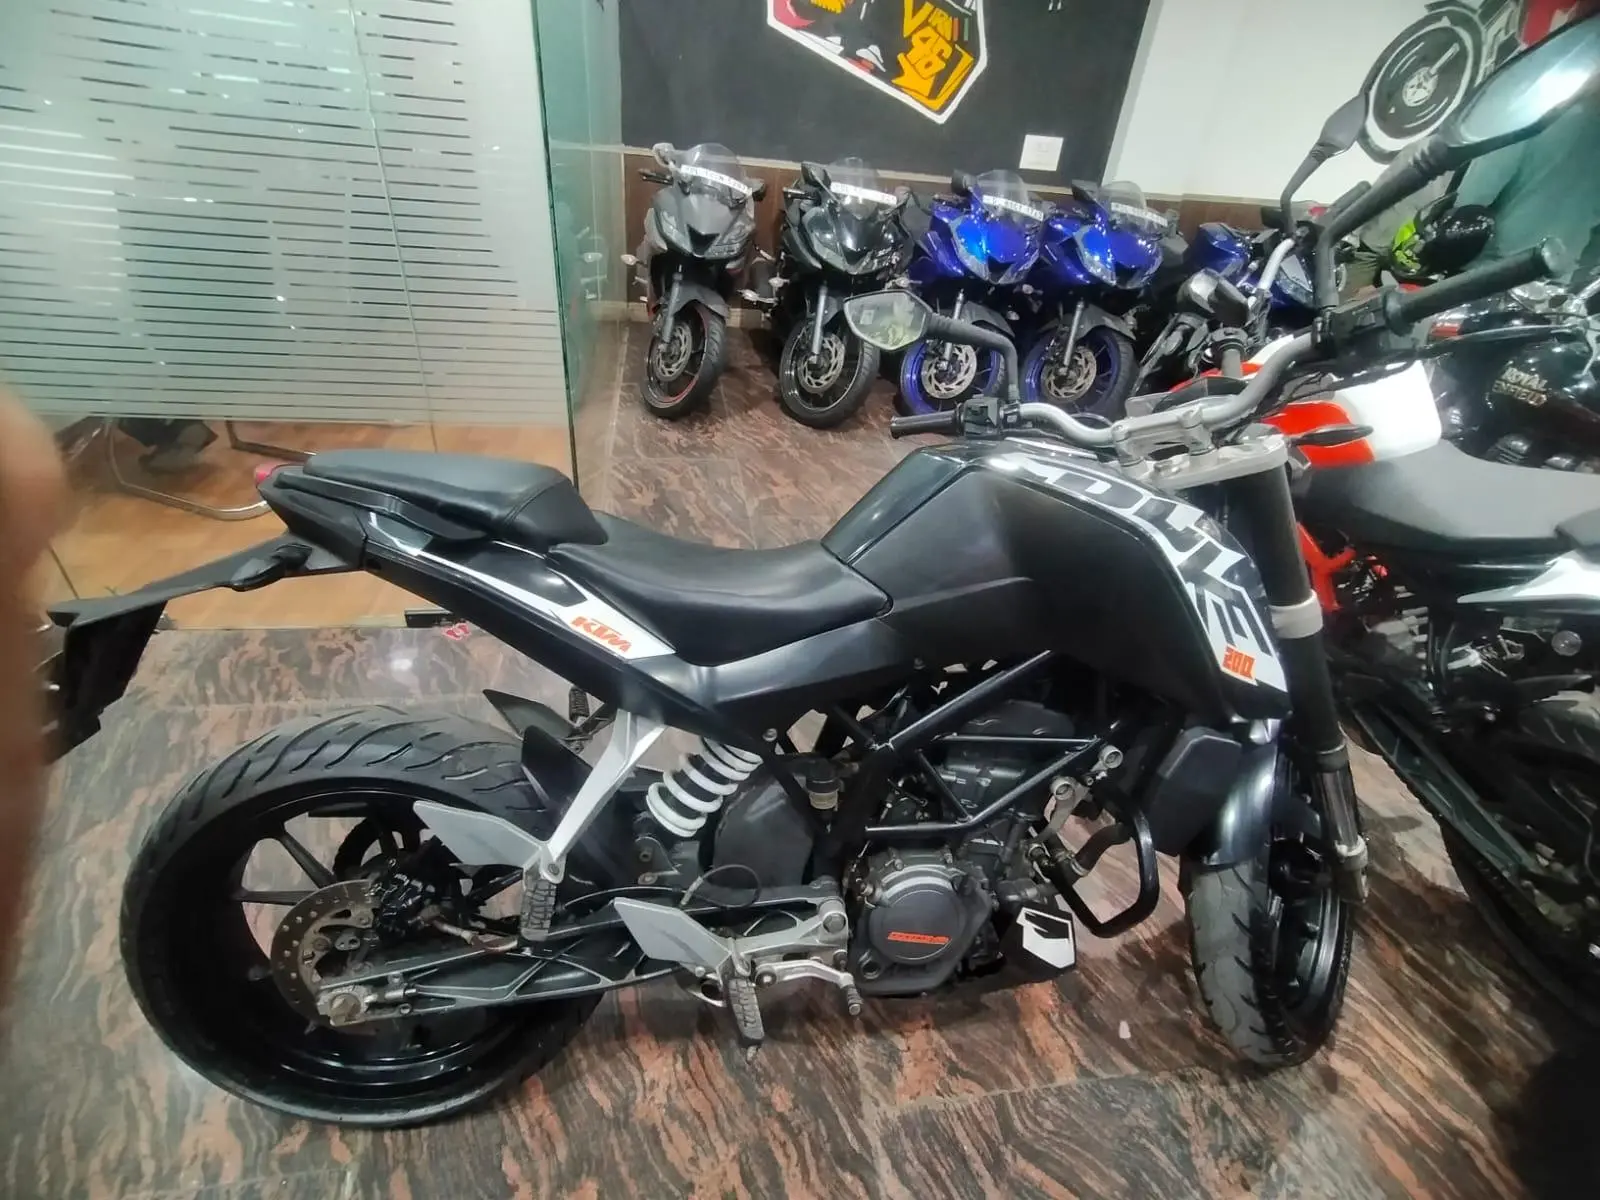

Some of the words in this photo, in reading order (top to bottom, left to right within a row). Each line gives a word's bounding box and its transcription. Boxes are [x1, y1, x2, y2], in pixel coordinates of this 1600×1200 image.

[1492, 380, 1547, 406] ENFIELD
[1502, 367, 1548, 391] ROYAL
[572, 616, 632, 652] KTM
[1222, 645, 1256, 680] 200
